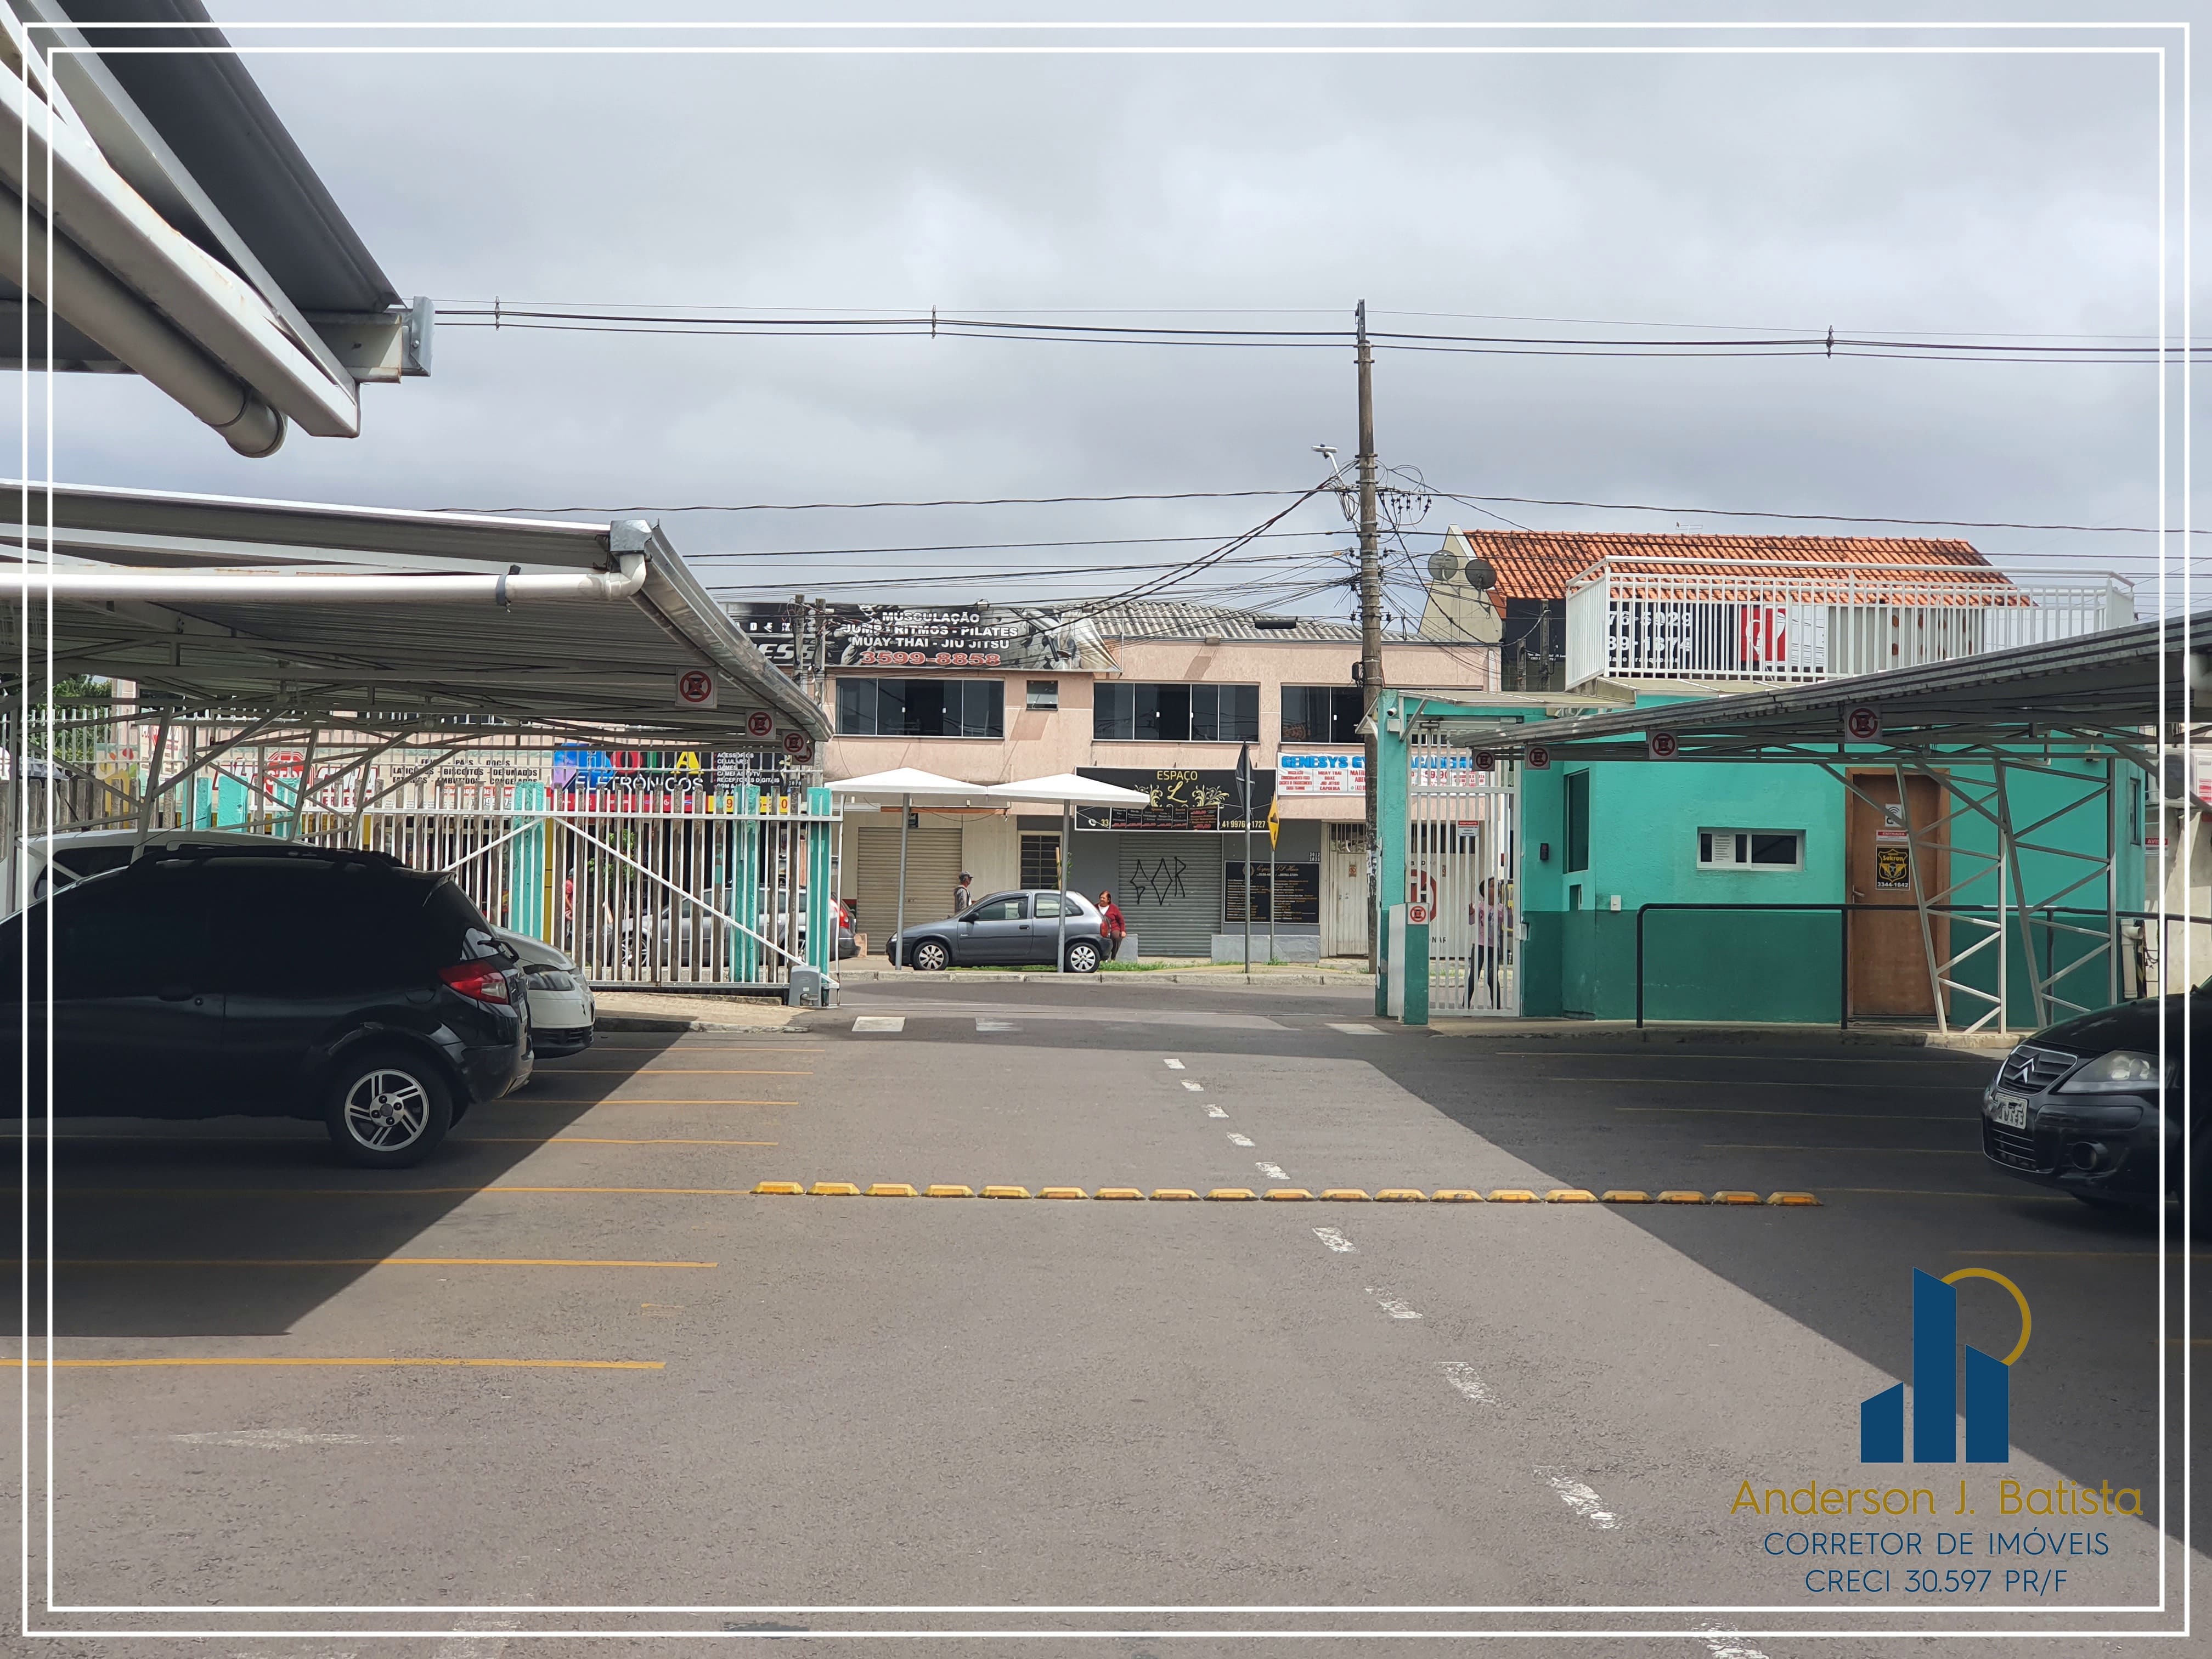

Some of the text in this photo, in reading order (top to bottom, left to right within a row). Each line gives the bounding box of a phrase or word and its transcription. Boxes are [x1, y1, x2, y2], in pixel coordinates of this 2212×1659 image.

[882, 612, 980, 625] MUSCULAÇÃO
[895, 625, 949, 635] RITMOS
[961, 627, 1018, 637] PILATES
[851, 637, 1009, 649] MUAY THAI JIU JITSU
[860, 651, 1001, 667] 3599-8858
[1281, 755, 1348, 769] GENESYS
[576, 774, 704, 792] ELETRÔNCOS
[1156, 770, 1198, 783] ESPAÇO
